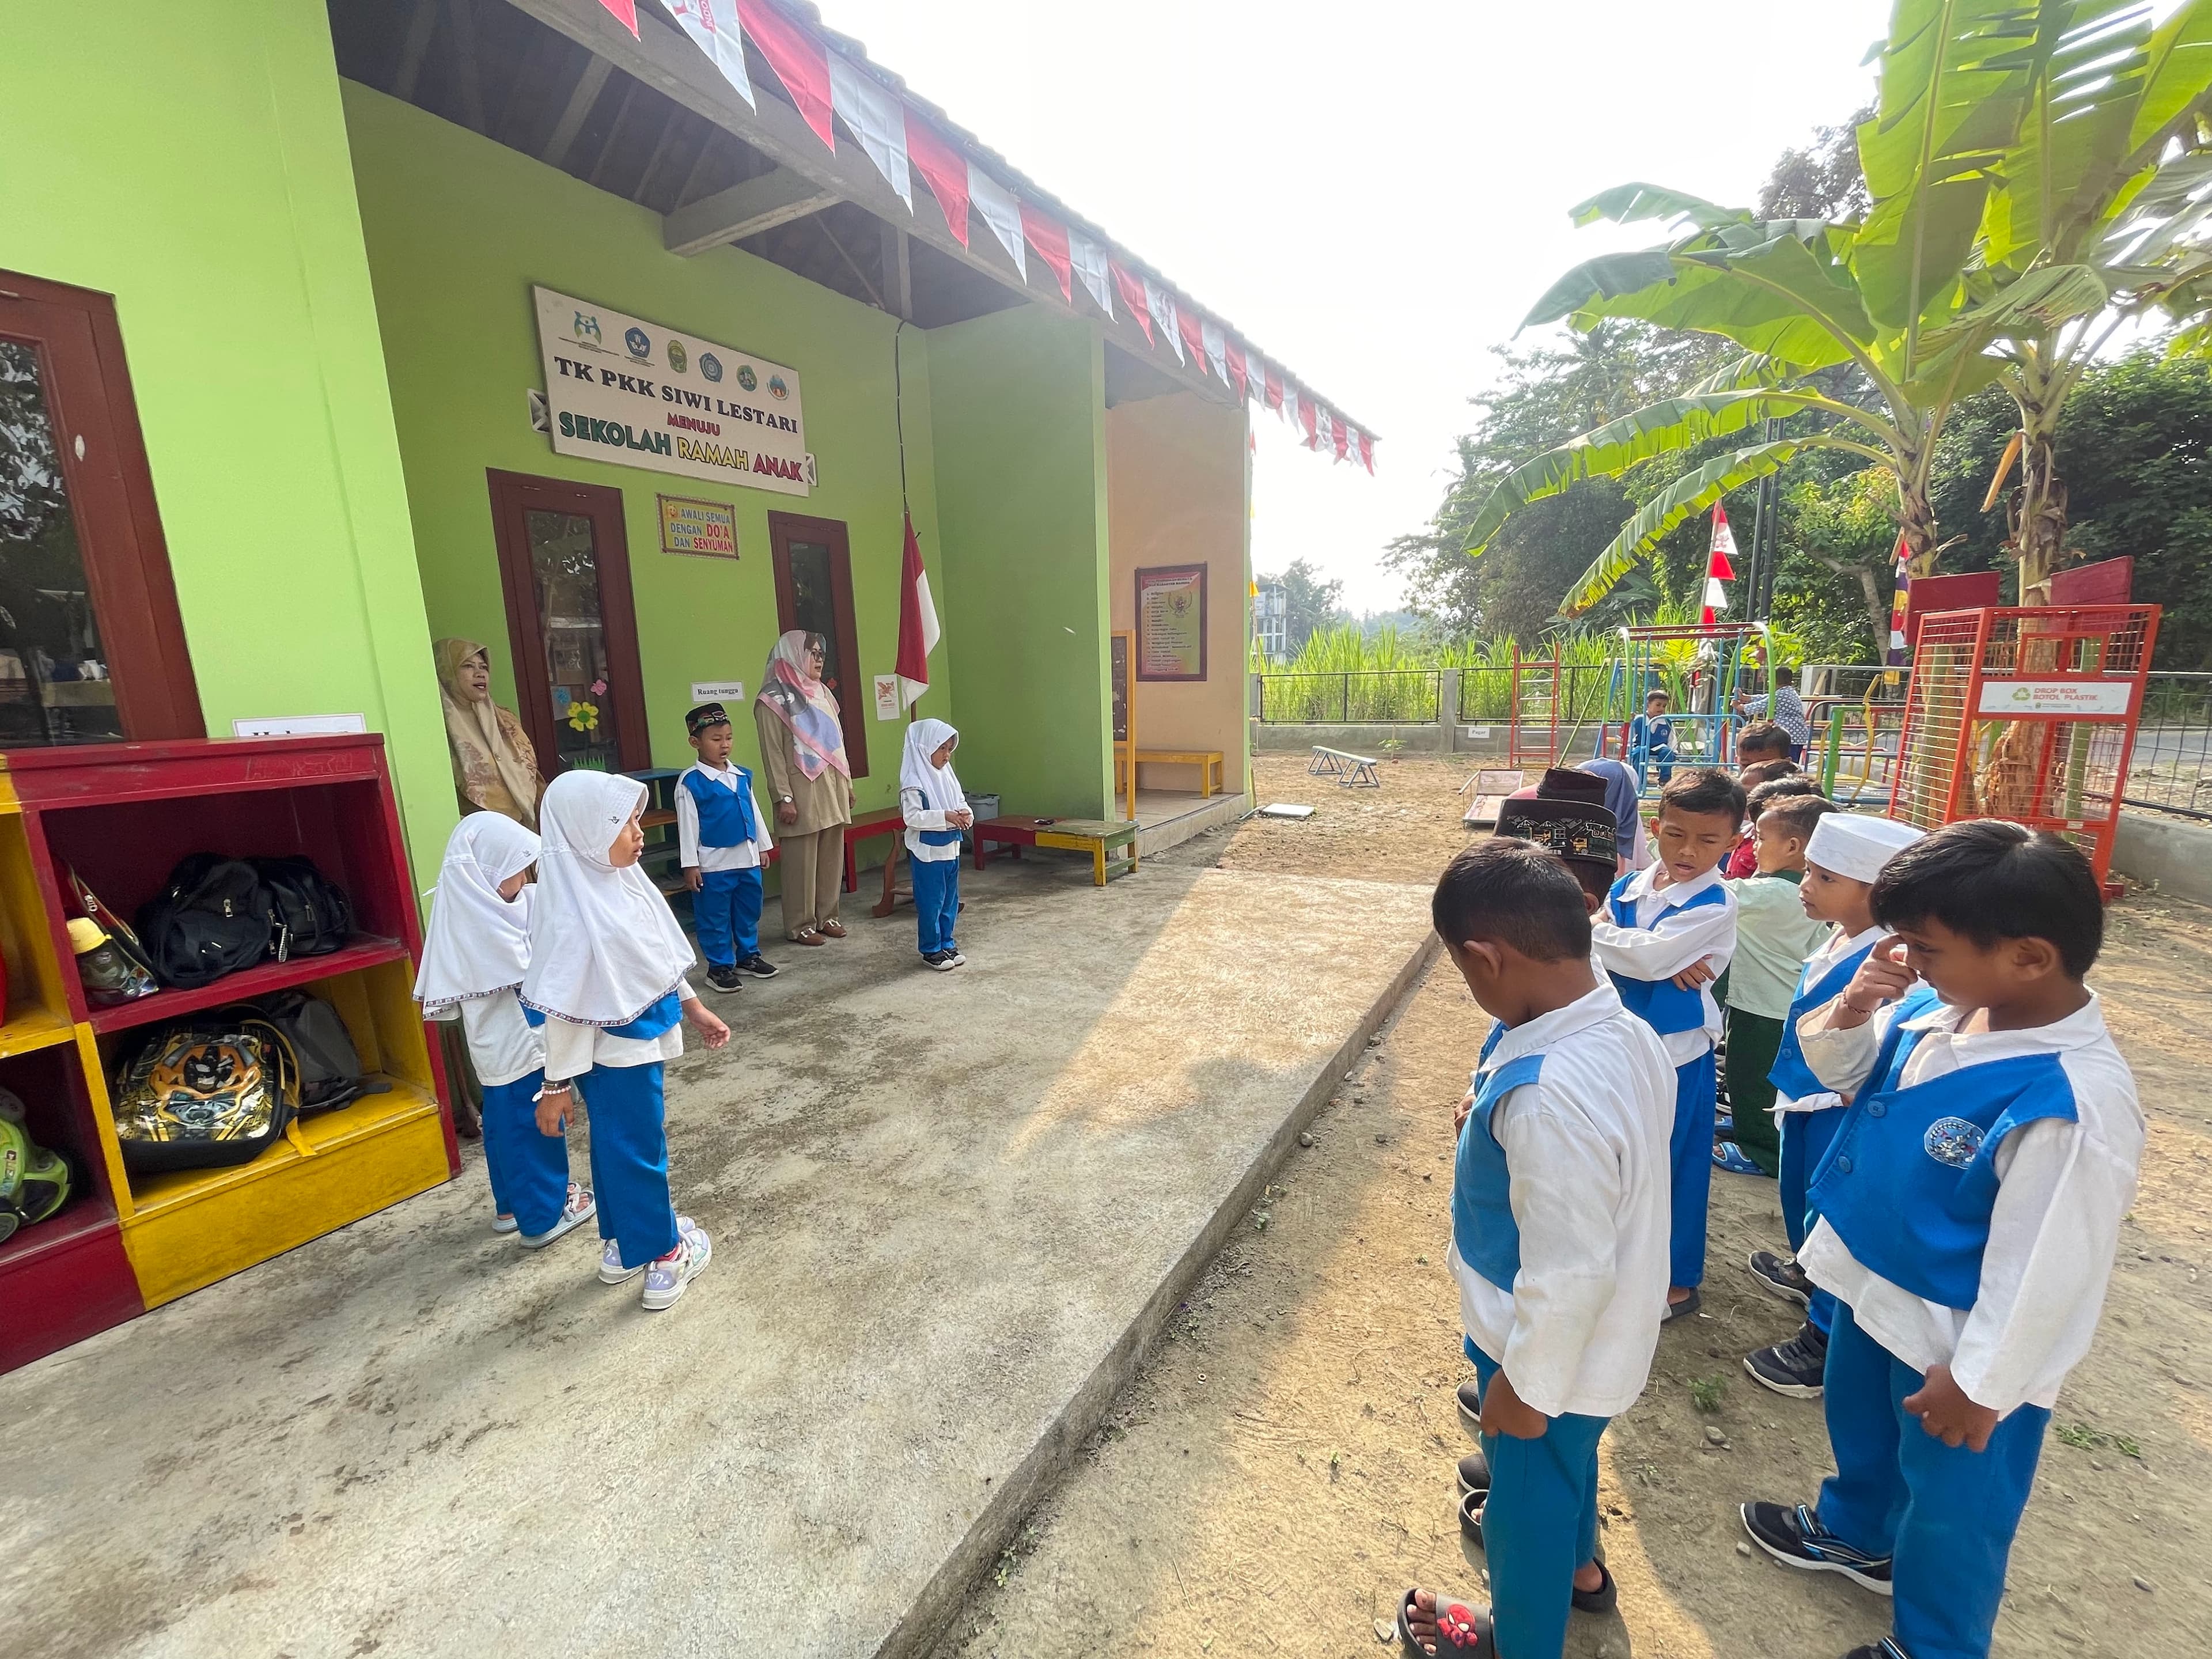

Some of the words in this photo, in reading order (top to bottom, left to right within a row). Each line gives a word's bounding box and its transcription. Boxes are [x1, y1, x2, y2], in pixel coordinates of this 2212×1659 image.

[701, 0, 713, 28] INDO
[554, 356, 594, 382] TK
[600, 368, 656, 397] PKK
[662, 385, 711, 412] SIWI
[717, 399, 798, 433] LESTARI
[667, 412, 721, 436] MENUJU
[559, 411, 672, 456] SEKOLAH
[677, 437, 749, 471] RAMAH
[753, 453, 804, 482] ANAK
[681, 509, 704, 521] AWALI
[706, 512, 730, 524] SEMUA
[671, 522, 702, 536] DENGAN
[706, 524, 730, 539] DO'A
[675, 537, 690, 547] DAN
[694, 537, 733, 552] SENYUMAN
